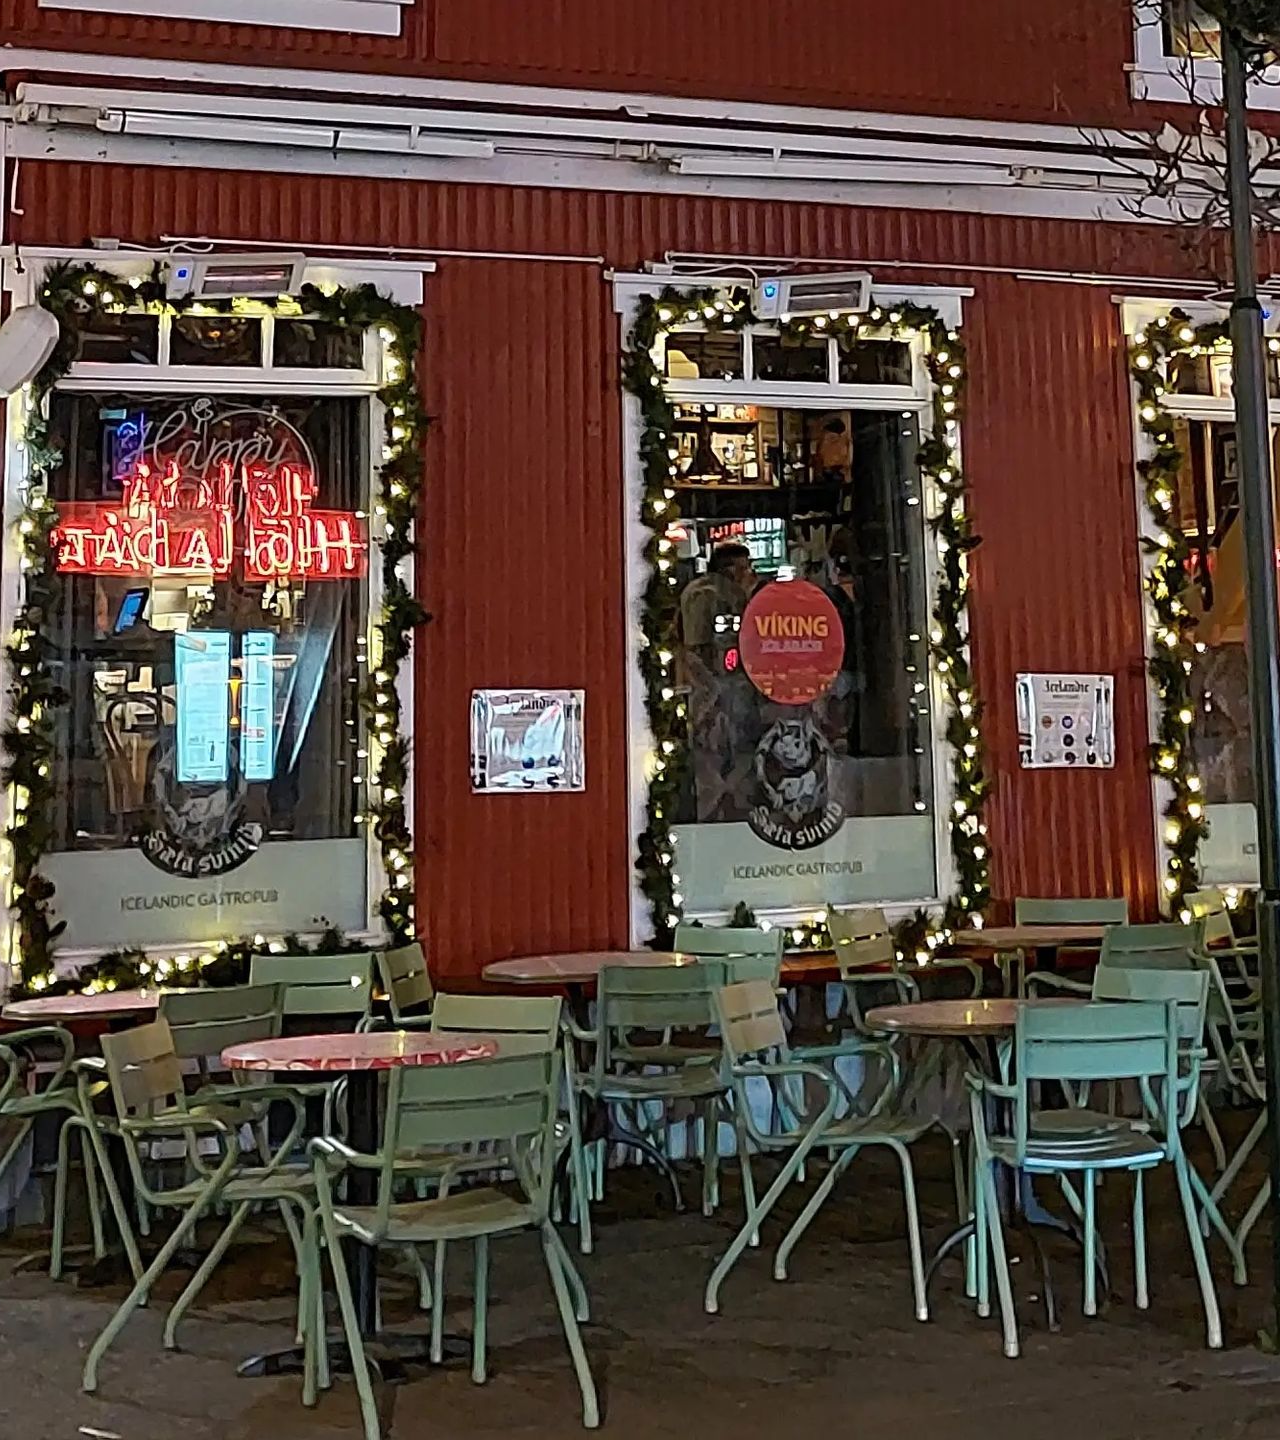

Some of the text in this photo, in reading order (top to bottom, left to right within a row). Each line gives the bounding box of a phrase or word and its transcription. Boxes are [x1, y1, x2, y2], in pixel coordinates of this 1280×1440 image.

[754, 610, 829, 637] VÍKING
[733, 861, 863, 879] ICELANDIC GASTROPUB
[121, 893, 196, 911] ICELANDIC
